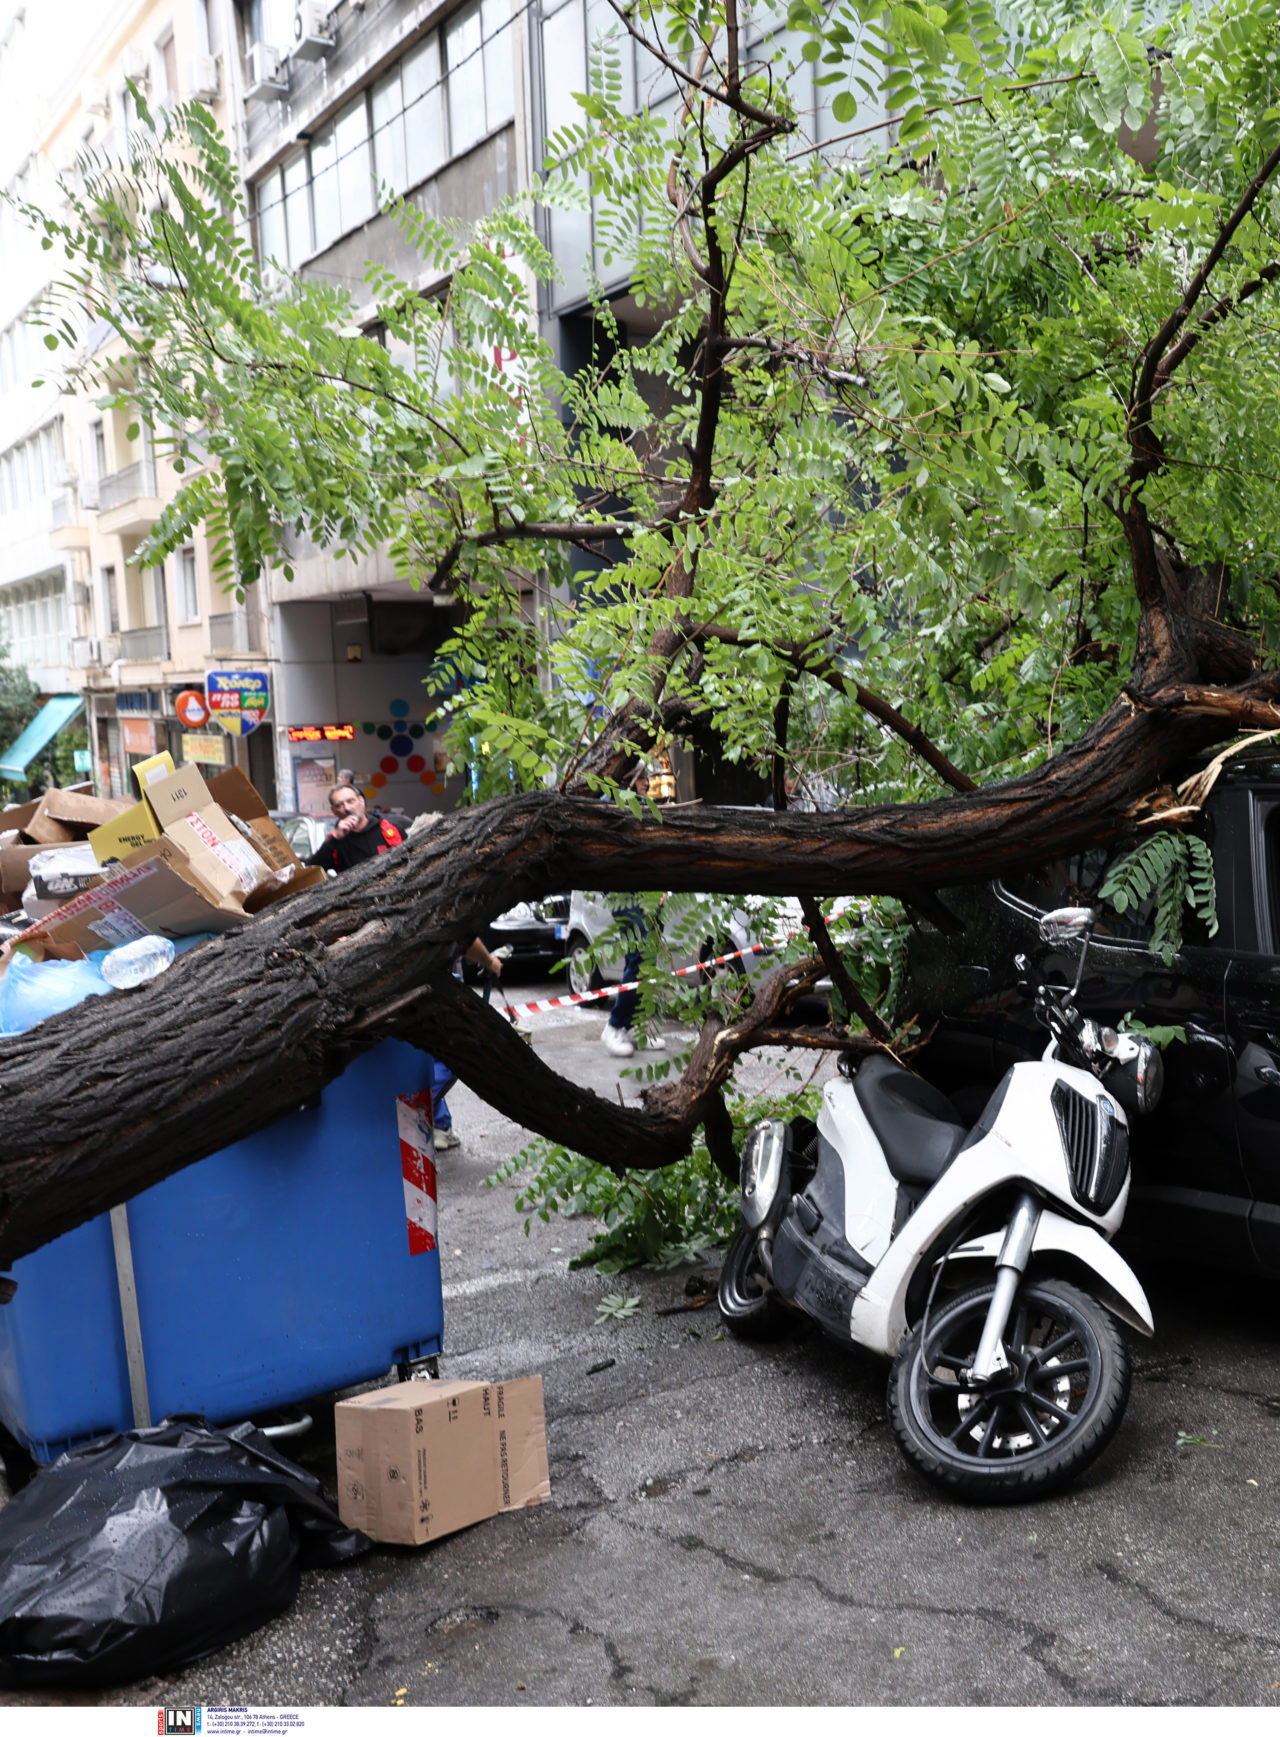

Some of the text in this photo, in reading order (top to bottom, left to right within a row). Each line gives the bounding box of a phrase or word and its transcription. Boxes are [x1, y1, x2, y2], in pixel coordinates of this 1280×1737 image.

[118, 835, 145, 843] ENERGY
[482, 1388, 491, 1416] HAUT
[414, 1408, 424, 1435] BAS
[497, 1386, 511, 1506] FRAGILE NE PAS RETOURNER
